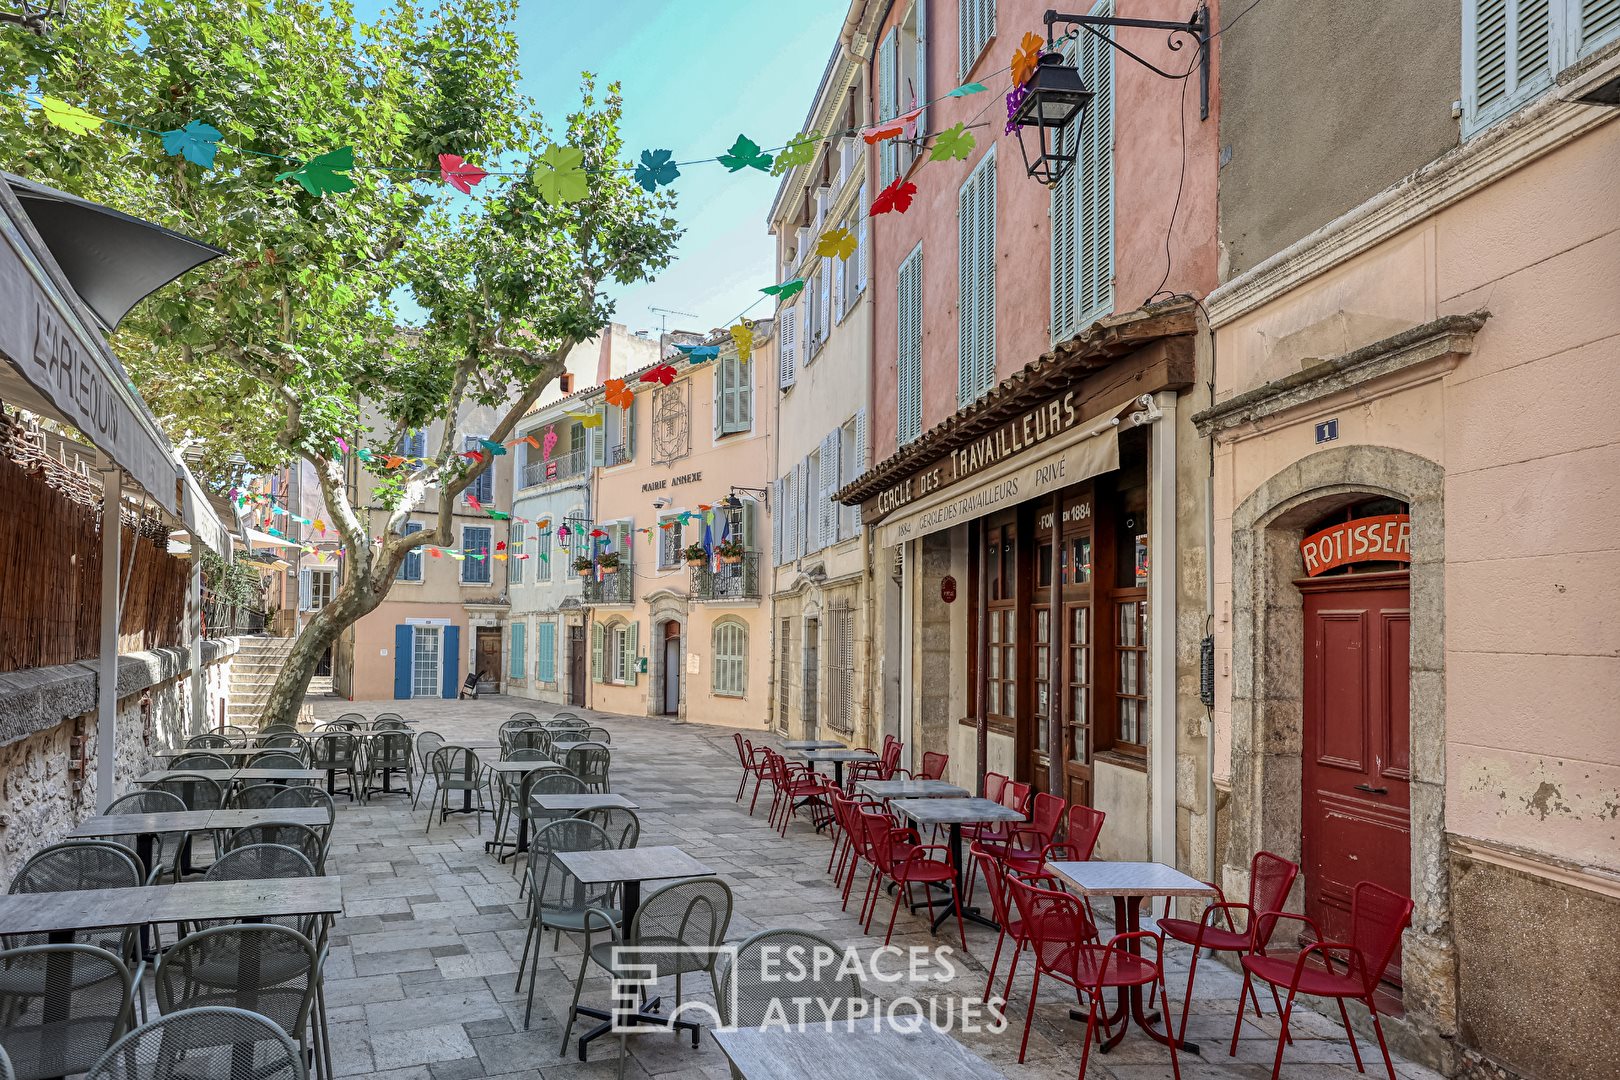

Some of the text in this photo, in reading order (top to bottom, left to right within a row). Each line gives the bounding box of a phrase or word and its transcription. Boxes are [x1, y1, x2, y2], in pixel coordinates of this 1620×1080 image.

[33, 302, 119, 445] L'ARLEQUIN
[878, 391, 1075, 514] CERCLE DES TRAVAILLEURS
[1322, 424, 1330, 439] 1
[641, 471, 703, 493] MAIRIE ANNEXE
[944, 503, 957, 521] DES
[958, 477, 1018, 515] TRAVAILLEURS
[1035, 455, 1066, 486] PRIVÉ
[1071, 502, 1091, 521] 1884
